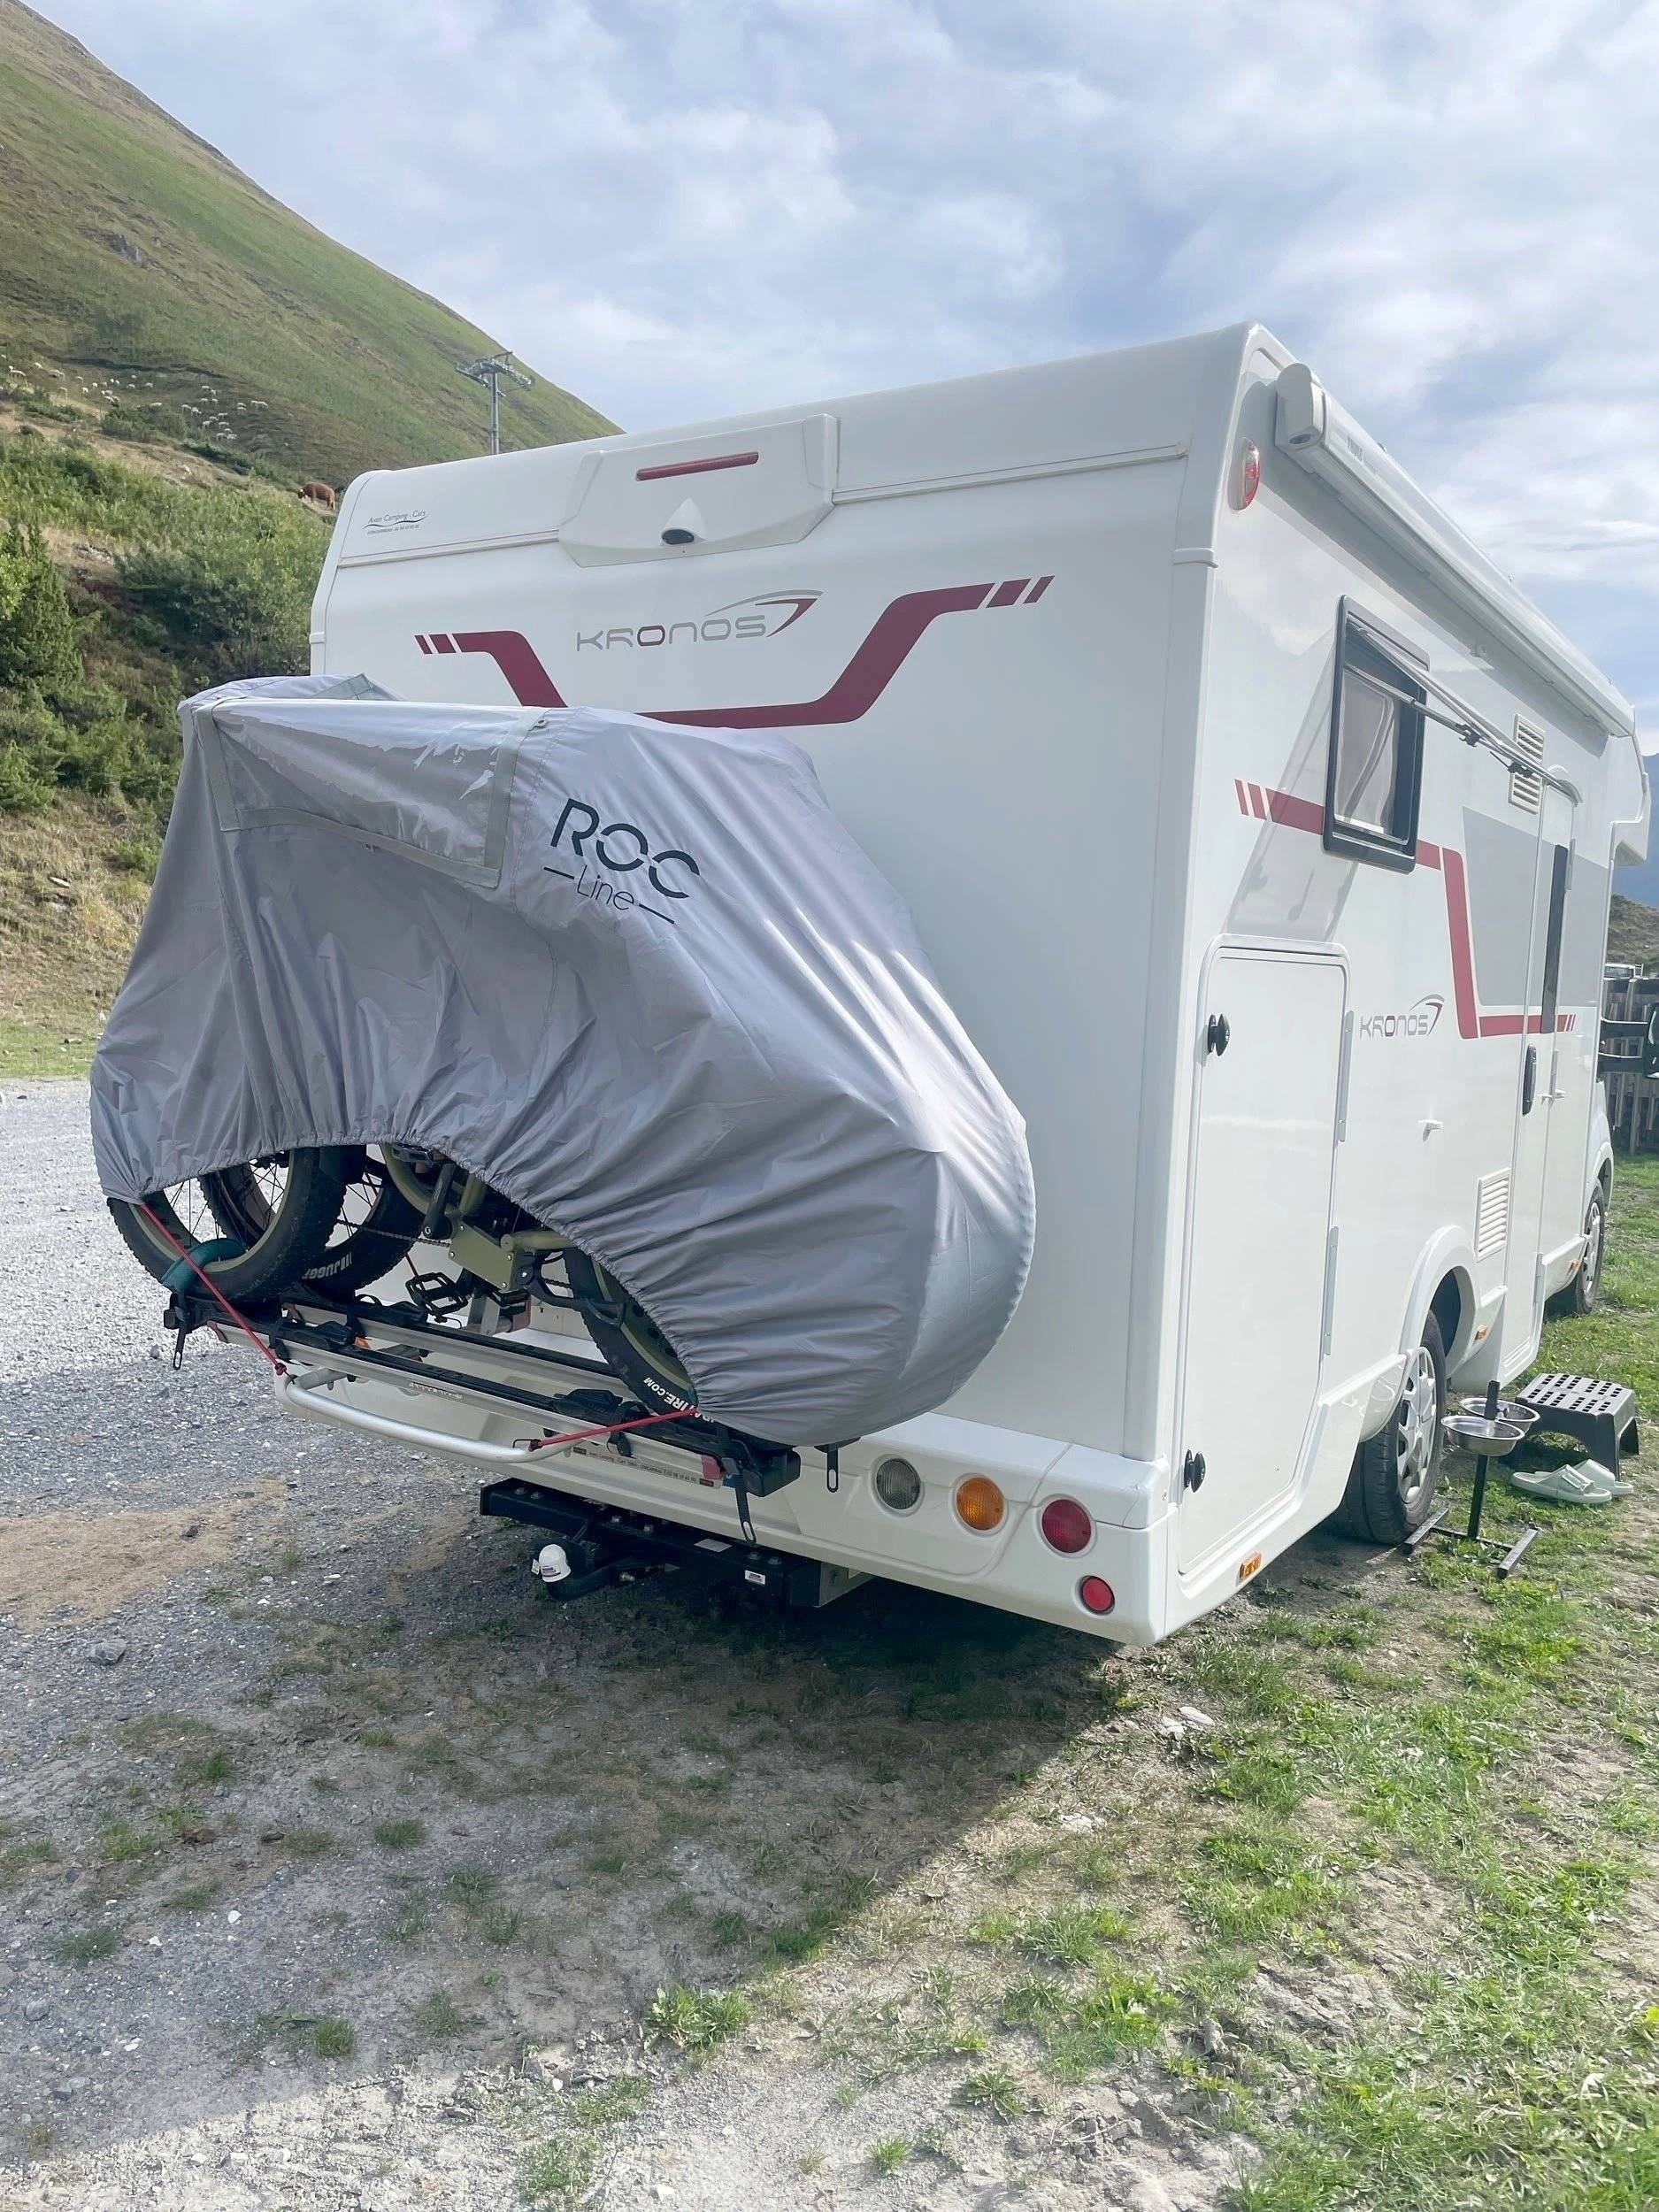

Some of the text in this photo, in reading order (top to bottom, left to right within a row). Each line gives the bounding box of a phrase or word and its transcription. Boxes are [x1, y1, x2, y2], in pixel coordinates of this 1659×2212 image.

[576, 615, 767, 652] KRONOS
[550, 797, 701, 899] ROC
[577, 864, 635, 910] Line
[1359, 1014, 1429, 1040] KRONOS
